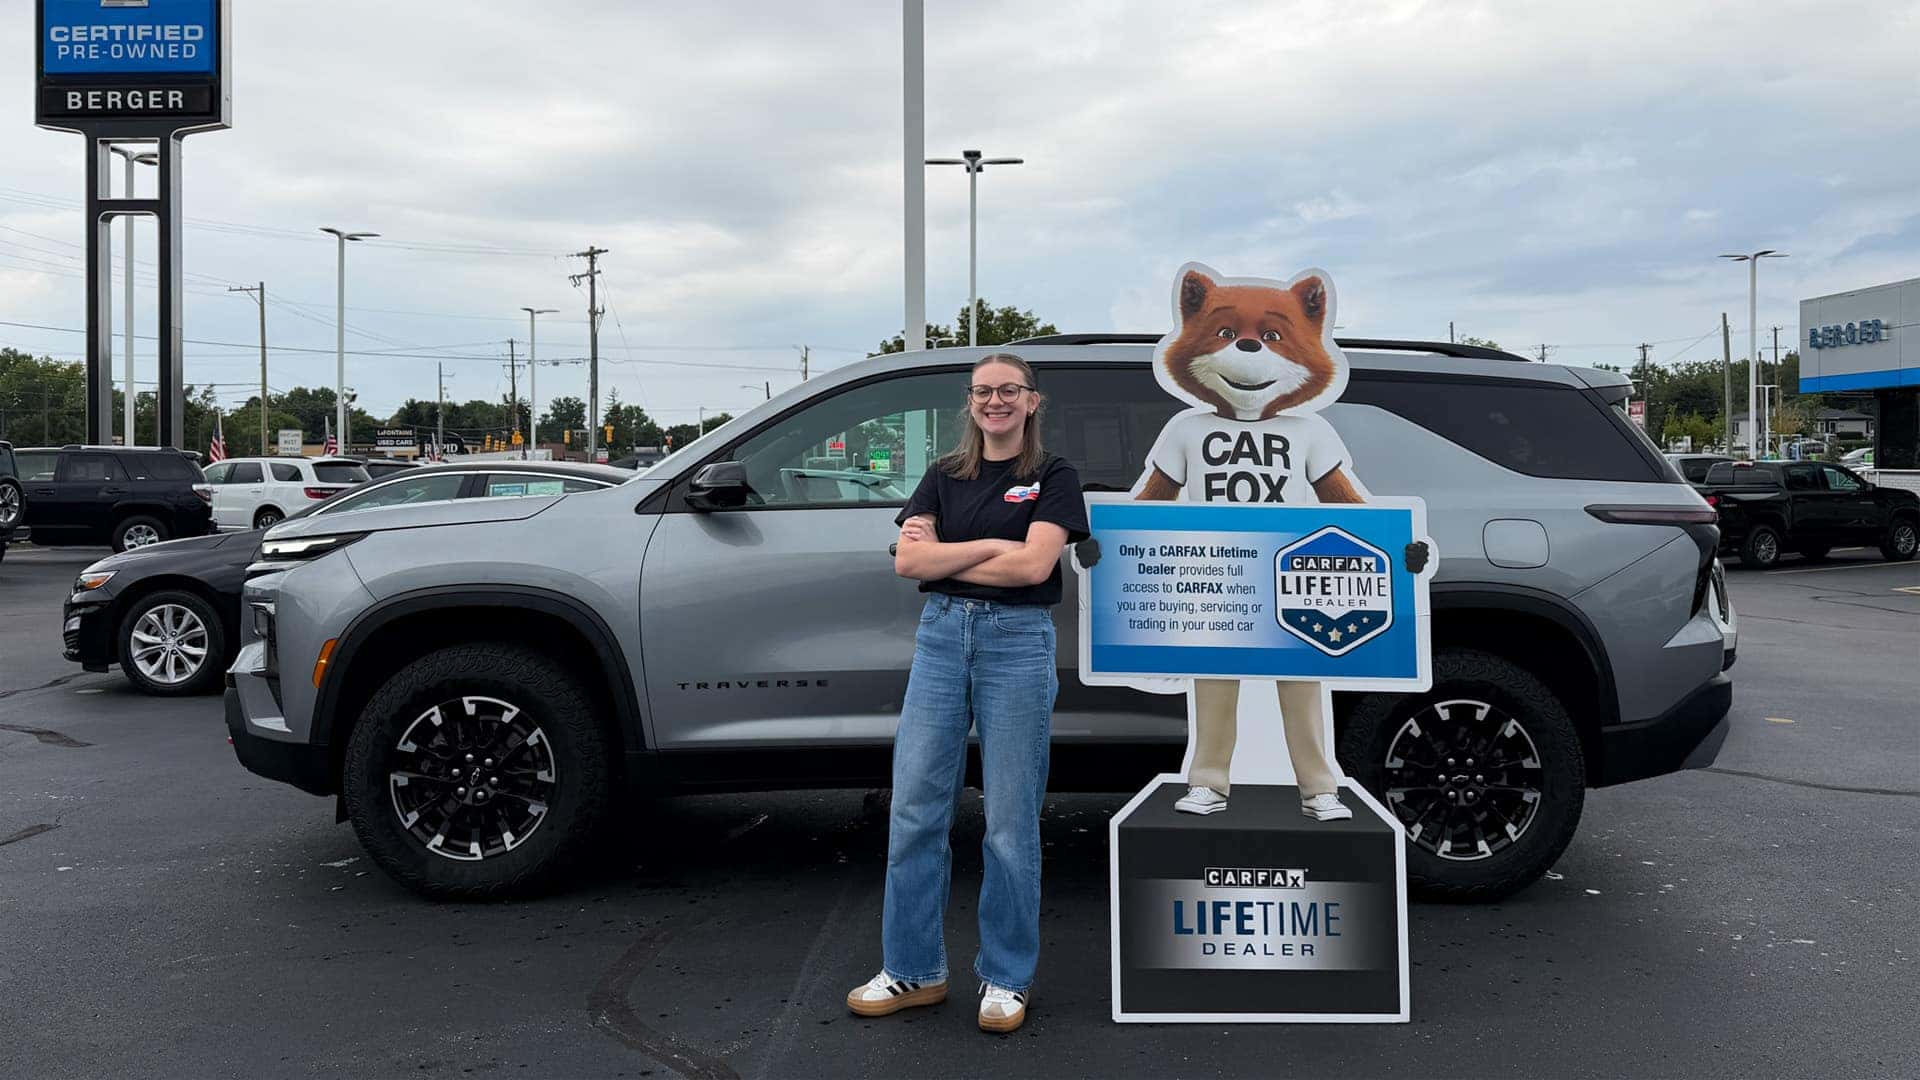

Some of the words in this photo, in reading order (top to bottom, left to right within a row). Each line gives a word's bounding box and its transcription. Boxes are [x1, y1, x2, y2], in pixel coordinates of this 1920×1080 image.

[50, 25, 204, 42] CERTIFIED
[58, 43, 196, 60] PRE-OWNED
[67, 91, 184, 110] BERGER
[1809, 319, 1882, 349] BERGER
[1202, 430, 1291, 470] CAR
[1204, 471, 1289, 503] FOX
[1119, 545, 1147, 559] Only
[1149, 548, 1156, 557] a
[1160, 545, 1206, 558] CARFAX
[1210, 546, 1258, 559] Lifetime
[1138, 563, 1176, 575] Dealer
[1179, 564, 1224, 578] provides
[1227, 565, 1243, 577] full
[1291, 557, 1375, 572] CARFAX
[1122, 583, 1159, 593] access
[1162, 583, 1173, 593] to
[1176, 582, 1223, 594] CARFAX
[1226, 583, 1256, 595] when
[1281, 575, 1387, 597] LIFETIME
[1117, 602, 1136, 613] you
[1139, 602, 1156, 612] are
[1159, 600, 1198, 614] buying,
[1200, 601, 1248, 615] servicing
[1251, 604, 1263, 613] or
[1303, 598, 1368, 607] DEALER
[1129, 618, 1166, 632] trading
[1169, 619, 1178, 630] in
[1182, 621, 1205, 633] your
[1208, 619, 1234, 631] used
[1237, 621, 1255, 632] car
[677, 679, 829, 690] TRAVERSE
[1207, 869, 1302, 887] CARFAX
[1173, 900, 1342, 937] LIFETIME
[1202, 942, 1315, 956] DEALER
